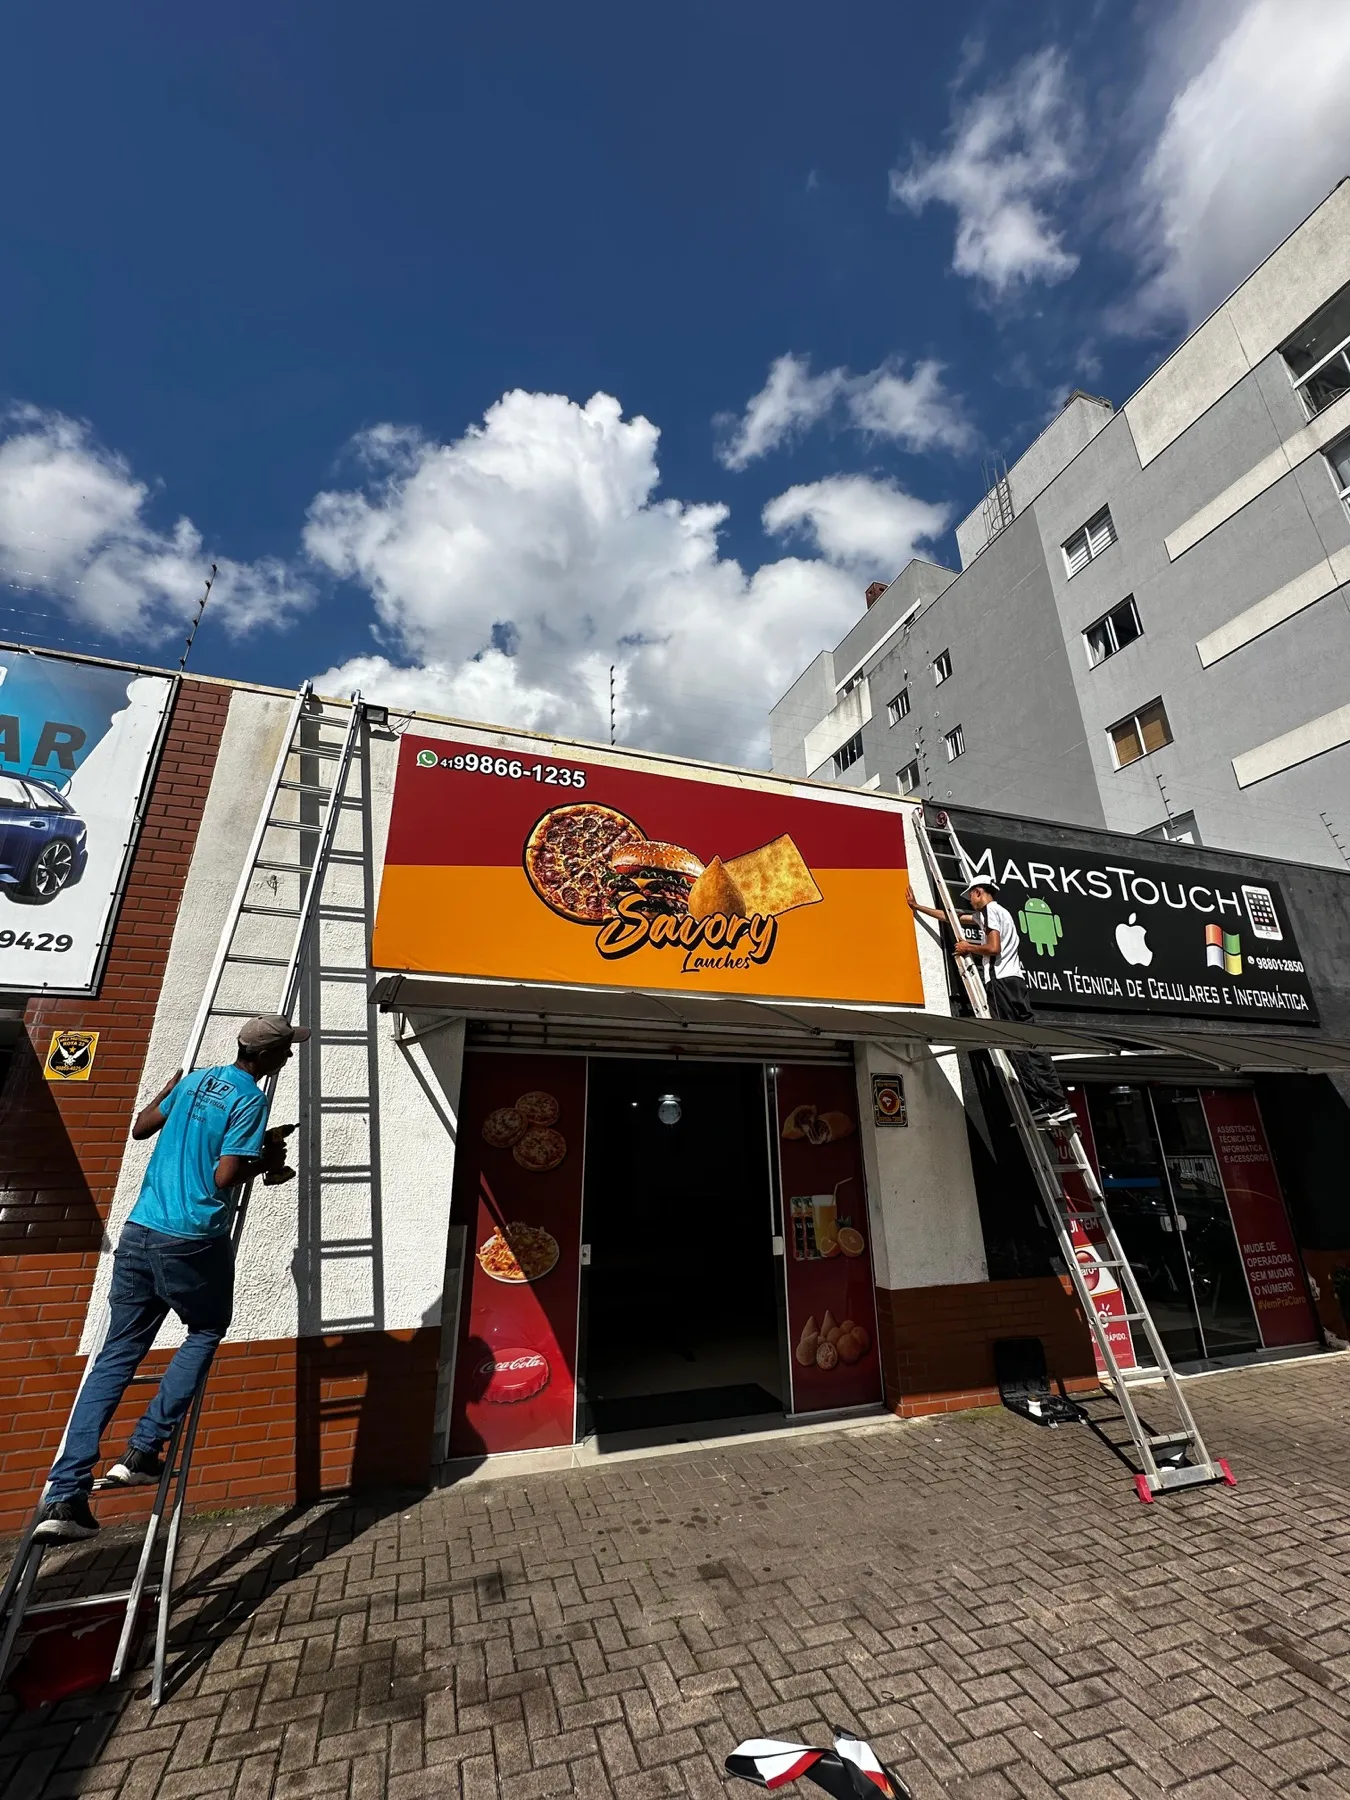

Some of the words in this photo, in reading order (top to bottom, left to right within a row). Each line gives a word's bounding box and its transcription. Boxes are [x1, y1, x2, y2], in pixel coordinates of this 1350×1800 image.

[596, 891, 778, 965] Savory
[680, 951, 751, 974] Lanches
[1256, 956, 1305, 973] 98801-2850
[1063, 966, 1123, 997] TÉCNICA
[1126, 979, 1145, 998] DE
[1147, 978, 1220, 1003] CELULARES
[1222, 987, 1232, 1005] E
[1233, 984, 1309, 1011] INFORMÁTICA
[1243, 1243, 1265, 1253] MUDE
[1266, 1242, 1277, 1251] DE
[1247, 1254, 1293, 1267] OPERADORA
[1250, 1270, 1267, 1281] SEM
[1268, 1268, 1295, 1279] MUDAR
[1254, 1286, 1260, 1296] O
